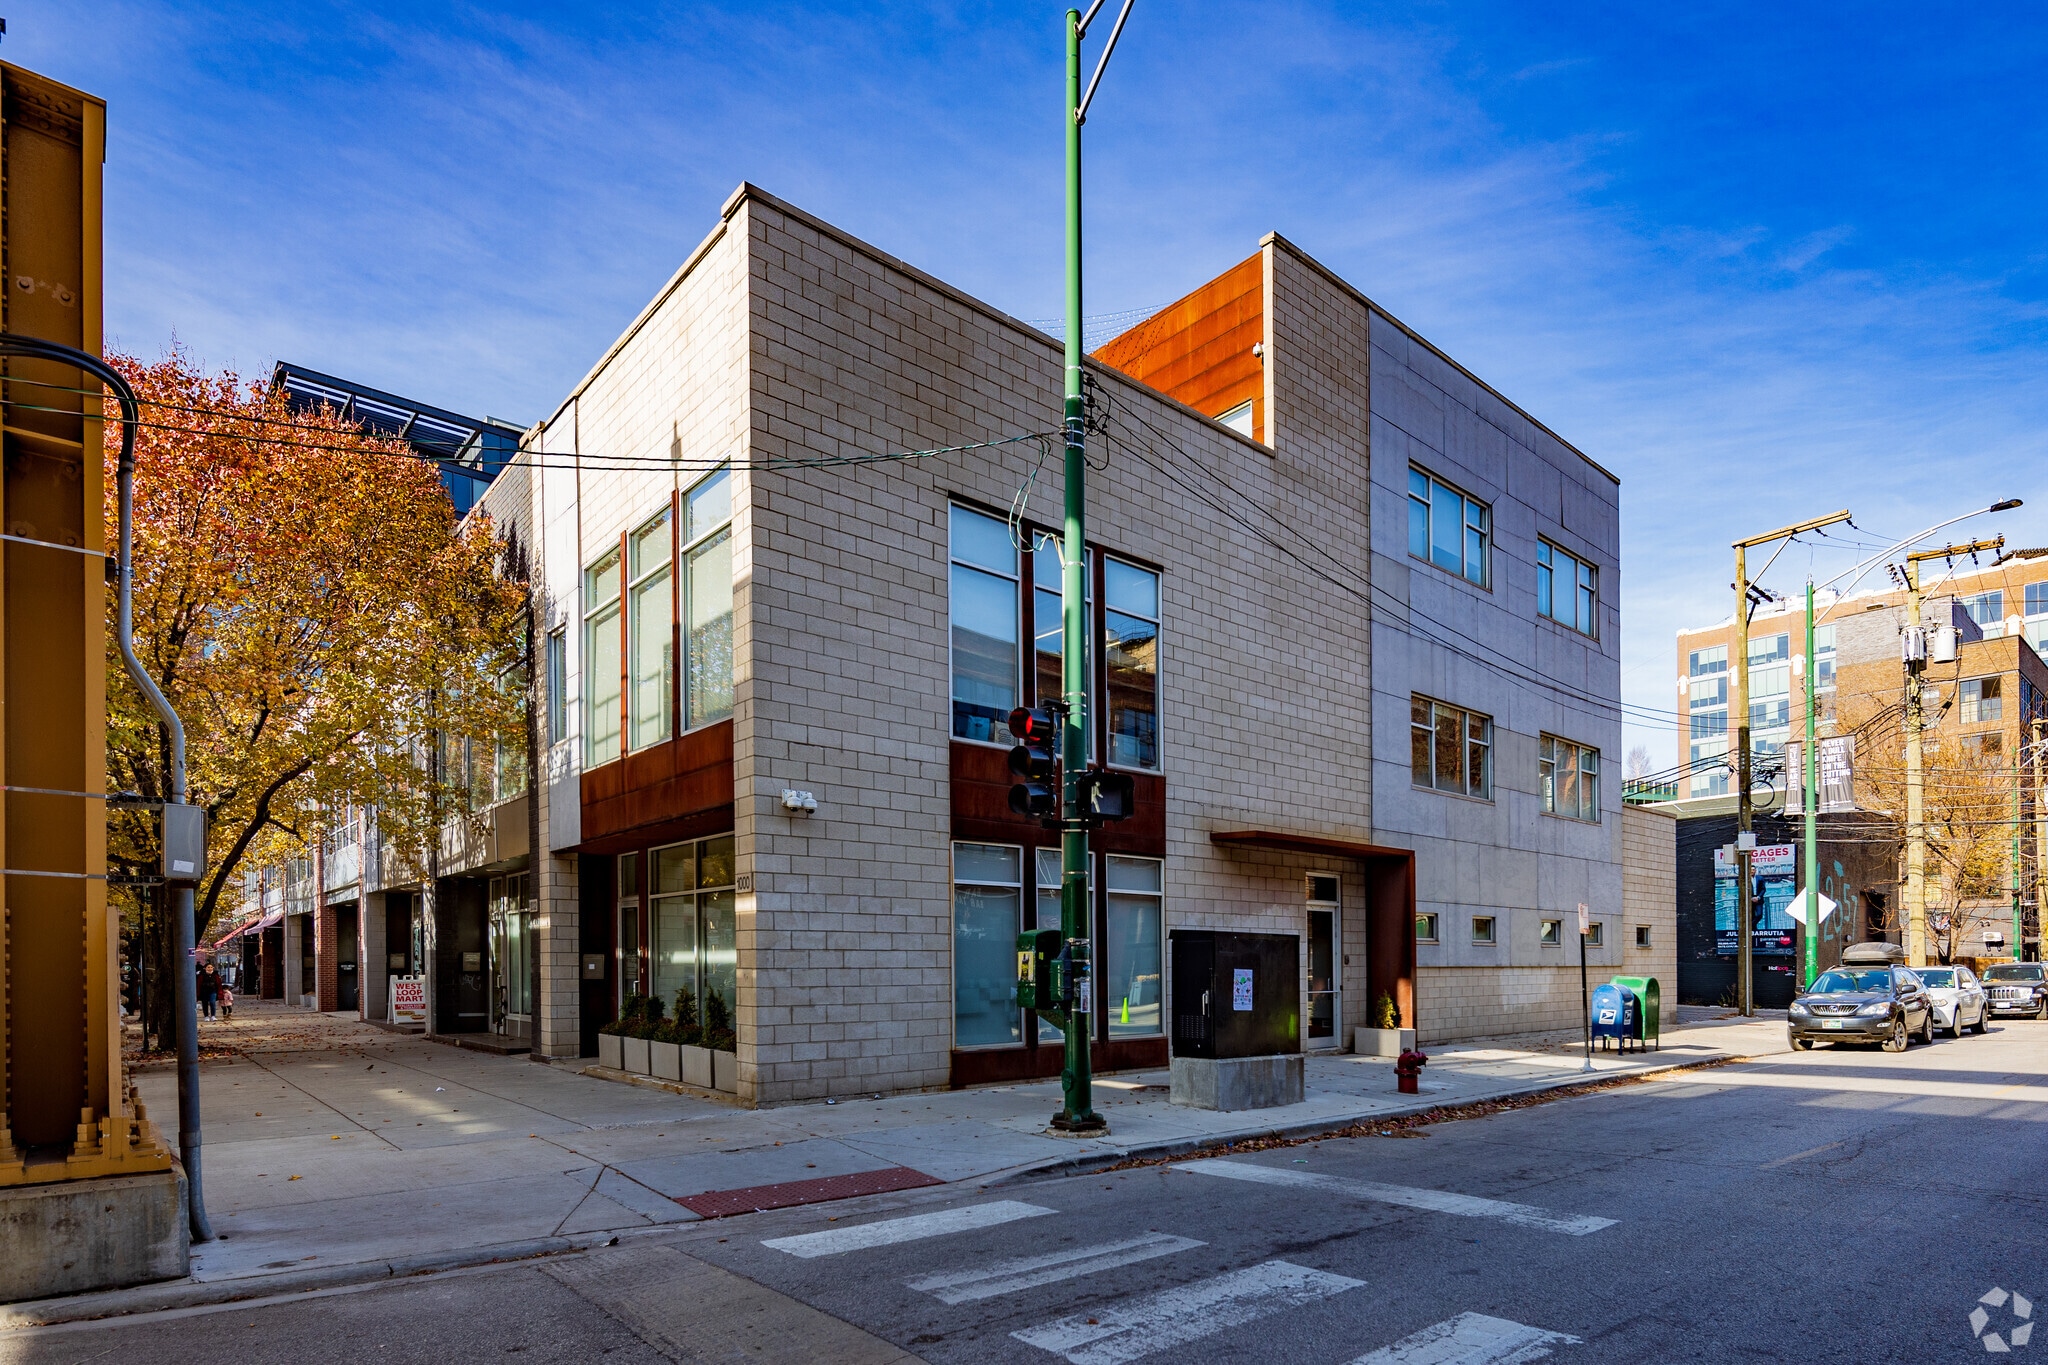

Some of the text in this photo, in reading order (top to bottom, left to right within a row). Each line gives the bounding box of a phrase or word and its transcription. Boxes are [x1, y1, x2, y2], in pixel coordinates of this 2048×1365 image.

[1822, 739, 1844, 748] NEVER
[1828, 747, 1845, 755] DULL
[1822, 754, 1842, 763] KNIFE
[1832, 761, 1847, 769] THE
[1822, 768, 1851, 778] CUTTING
[737, 876, 750, 890] 1000
